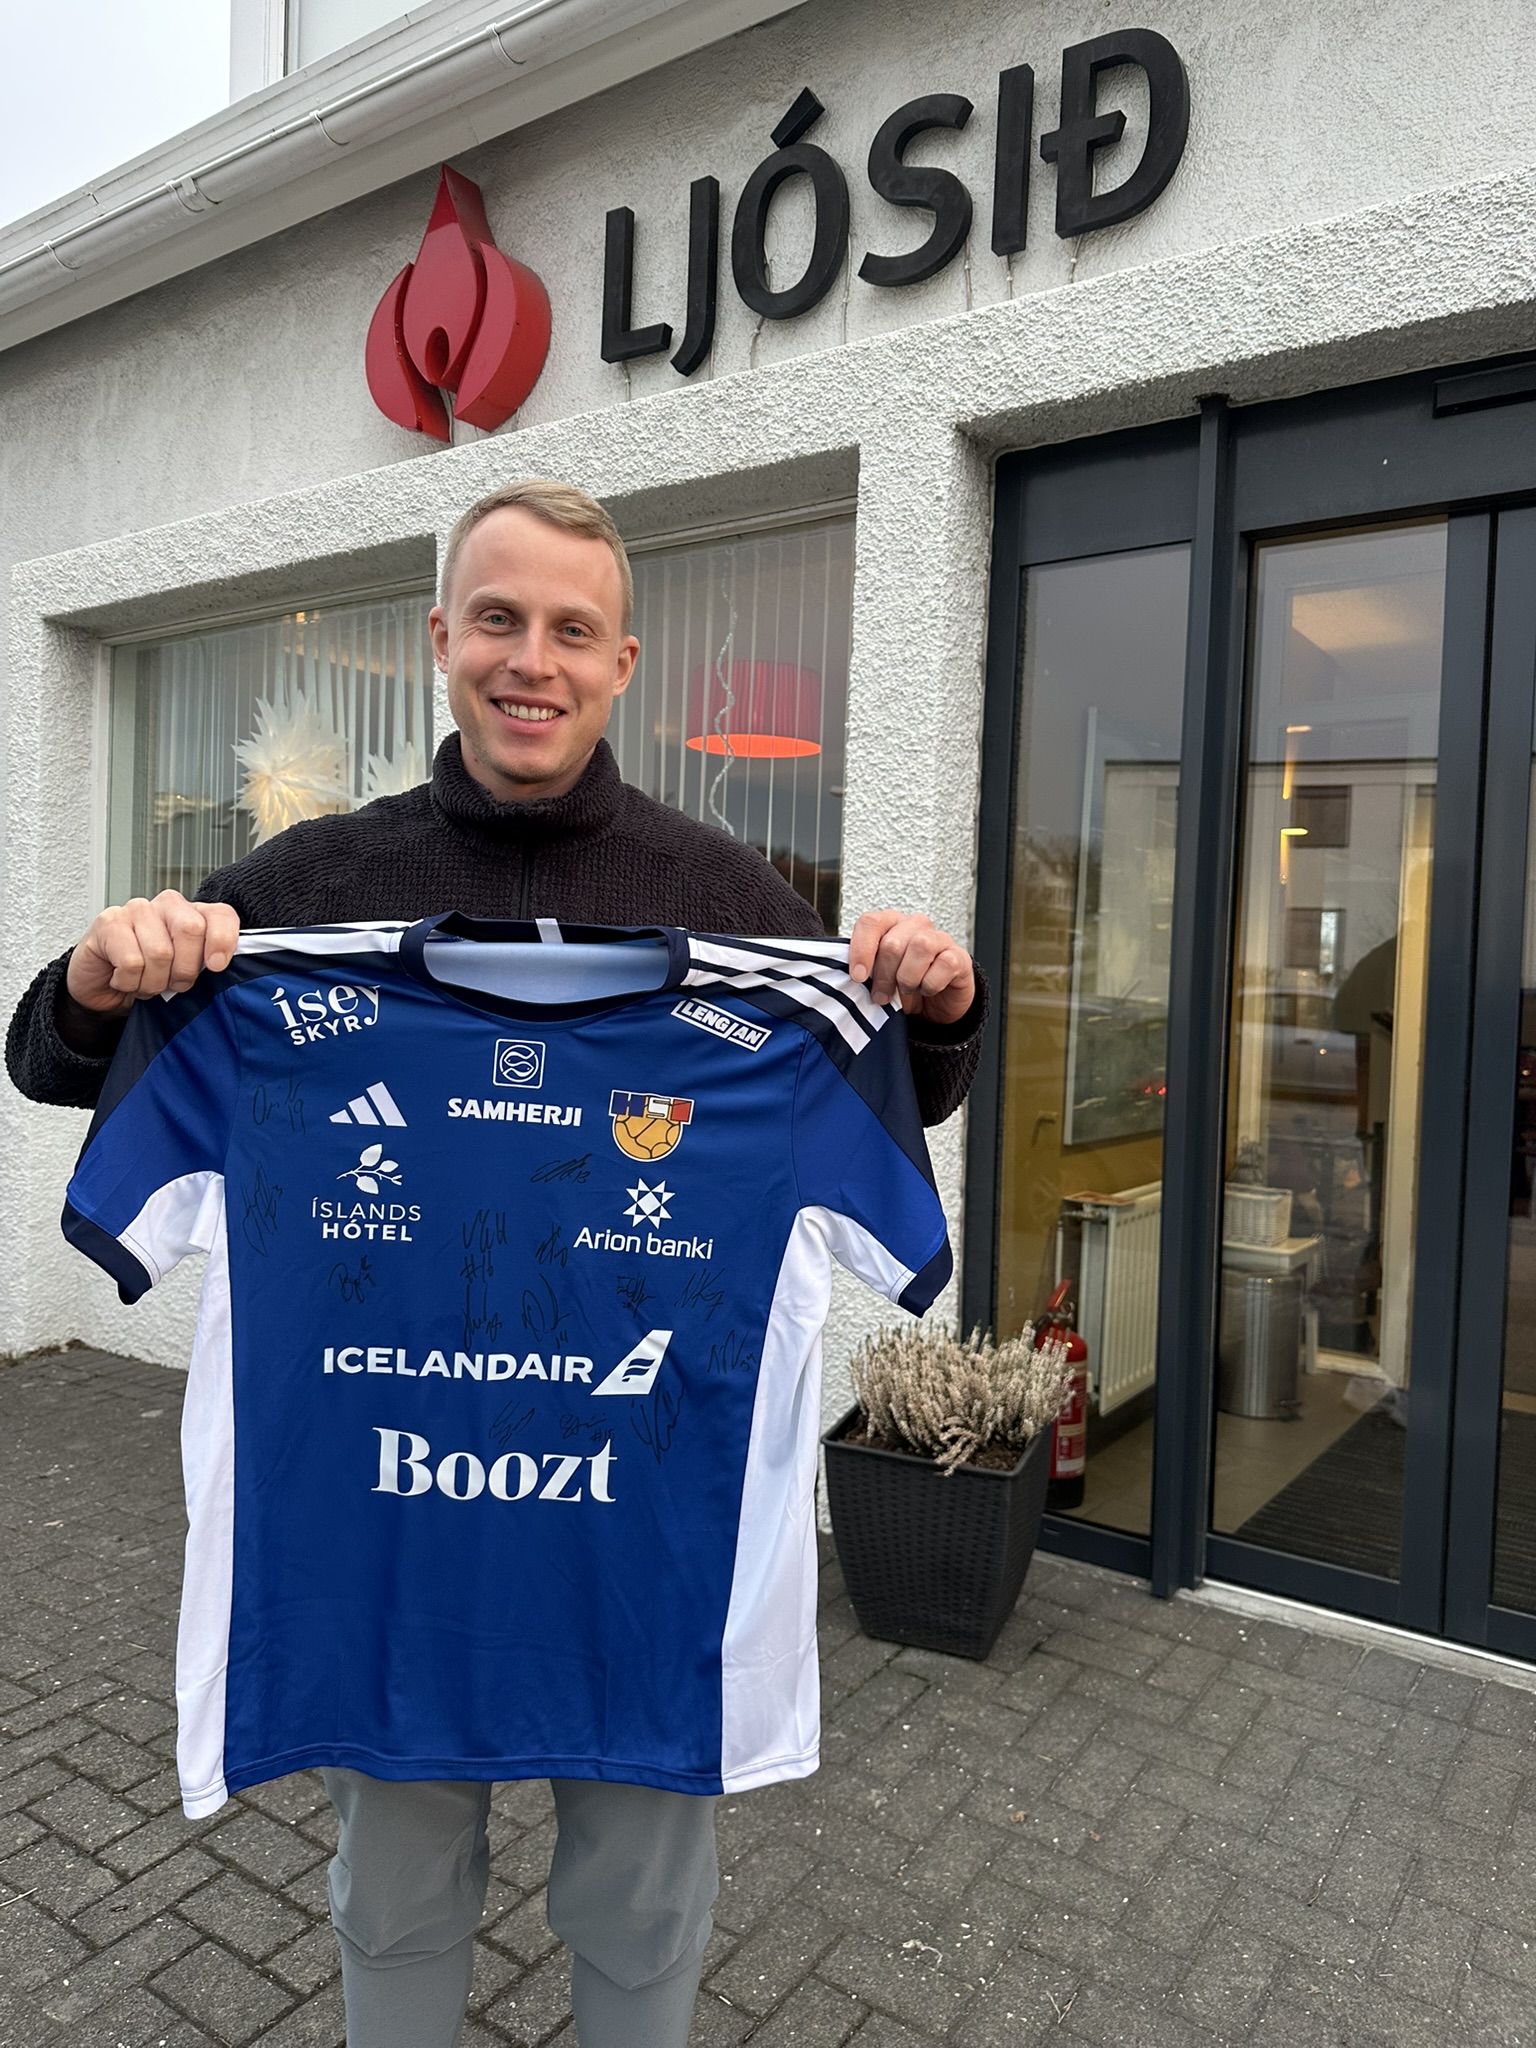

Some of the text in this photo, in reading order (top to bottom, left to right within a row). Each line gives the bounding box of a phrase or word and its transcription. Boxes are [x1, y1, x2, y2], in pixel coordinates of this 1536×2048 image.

[601, 28, 1191, 377] LJÓSIÐ
[290, 1014, 363, 1046] SKYR
[447, 1097, 583, 1127] SAMHERJI
[311, 1197, 422, 1222] ÍSLANDS
[322, 1219, 413, 1242] HÓTEL
[573, 1226, 641, 1254] Arion
[646, 1232, 714, 1260] banki
[323, 1347, 594, 1384] ICELANDAIR
[370, 1426, 618, 1503] Boozt
